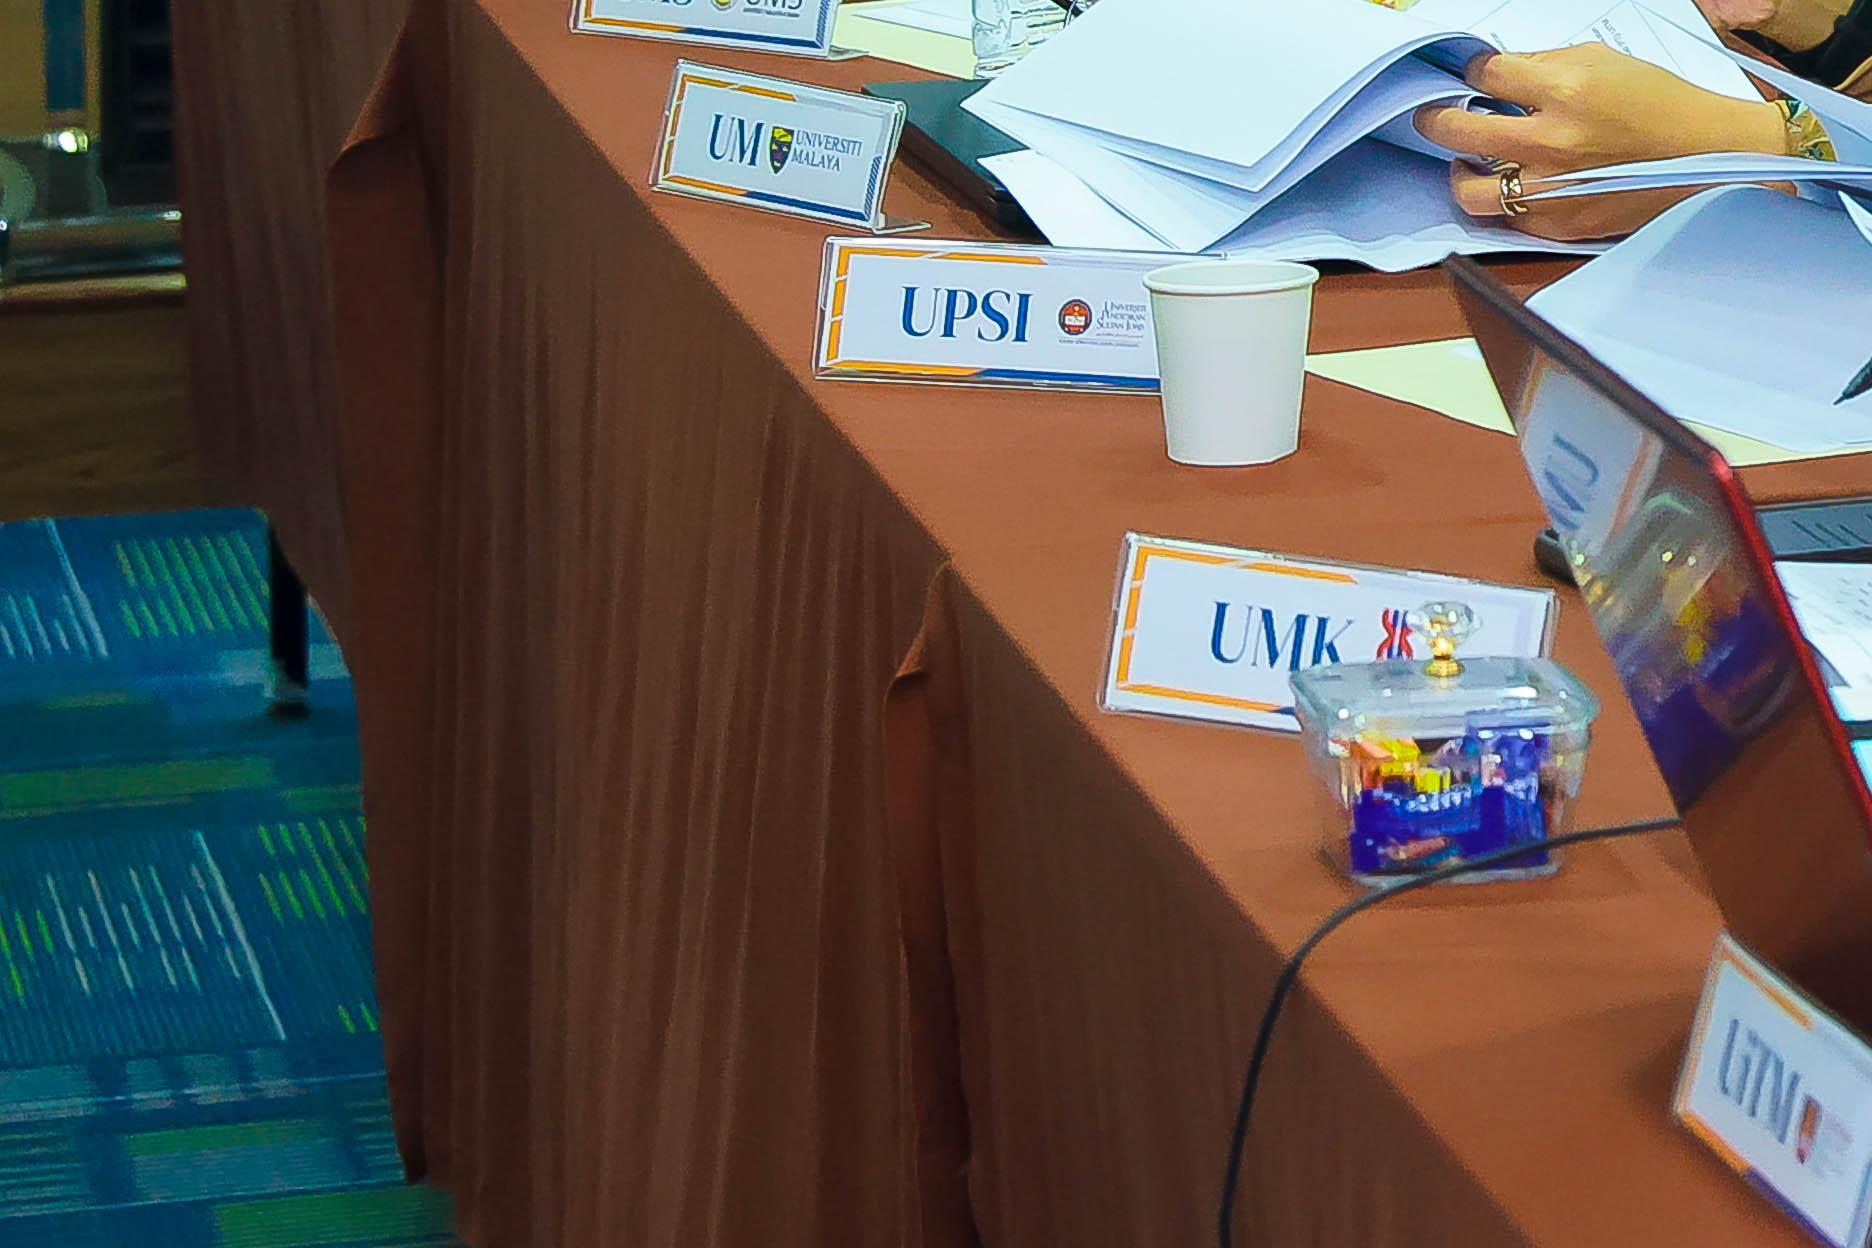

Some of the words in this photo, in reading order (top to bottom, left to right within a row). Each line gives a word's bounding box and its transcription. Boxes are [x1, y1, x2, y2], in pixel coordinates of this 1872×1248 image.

[708, 113, 765, 167] UM
[791, 149, 842, 172] MALAYA
[795, 130, 863, 157] UNIVERSITI
[901, 286, 1034, 343] UPSI
[1210, 601, 1355, 671] UMK
